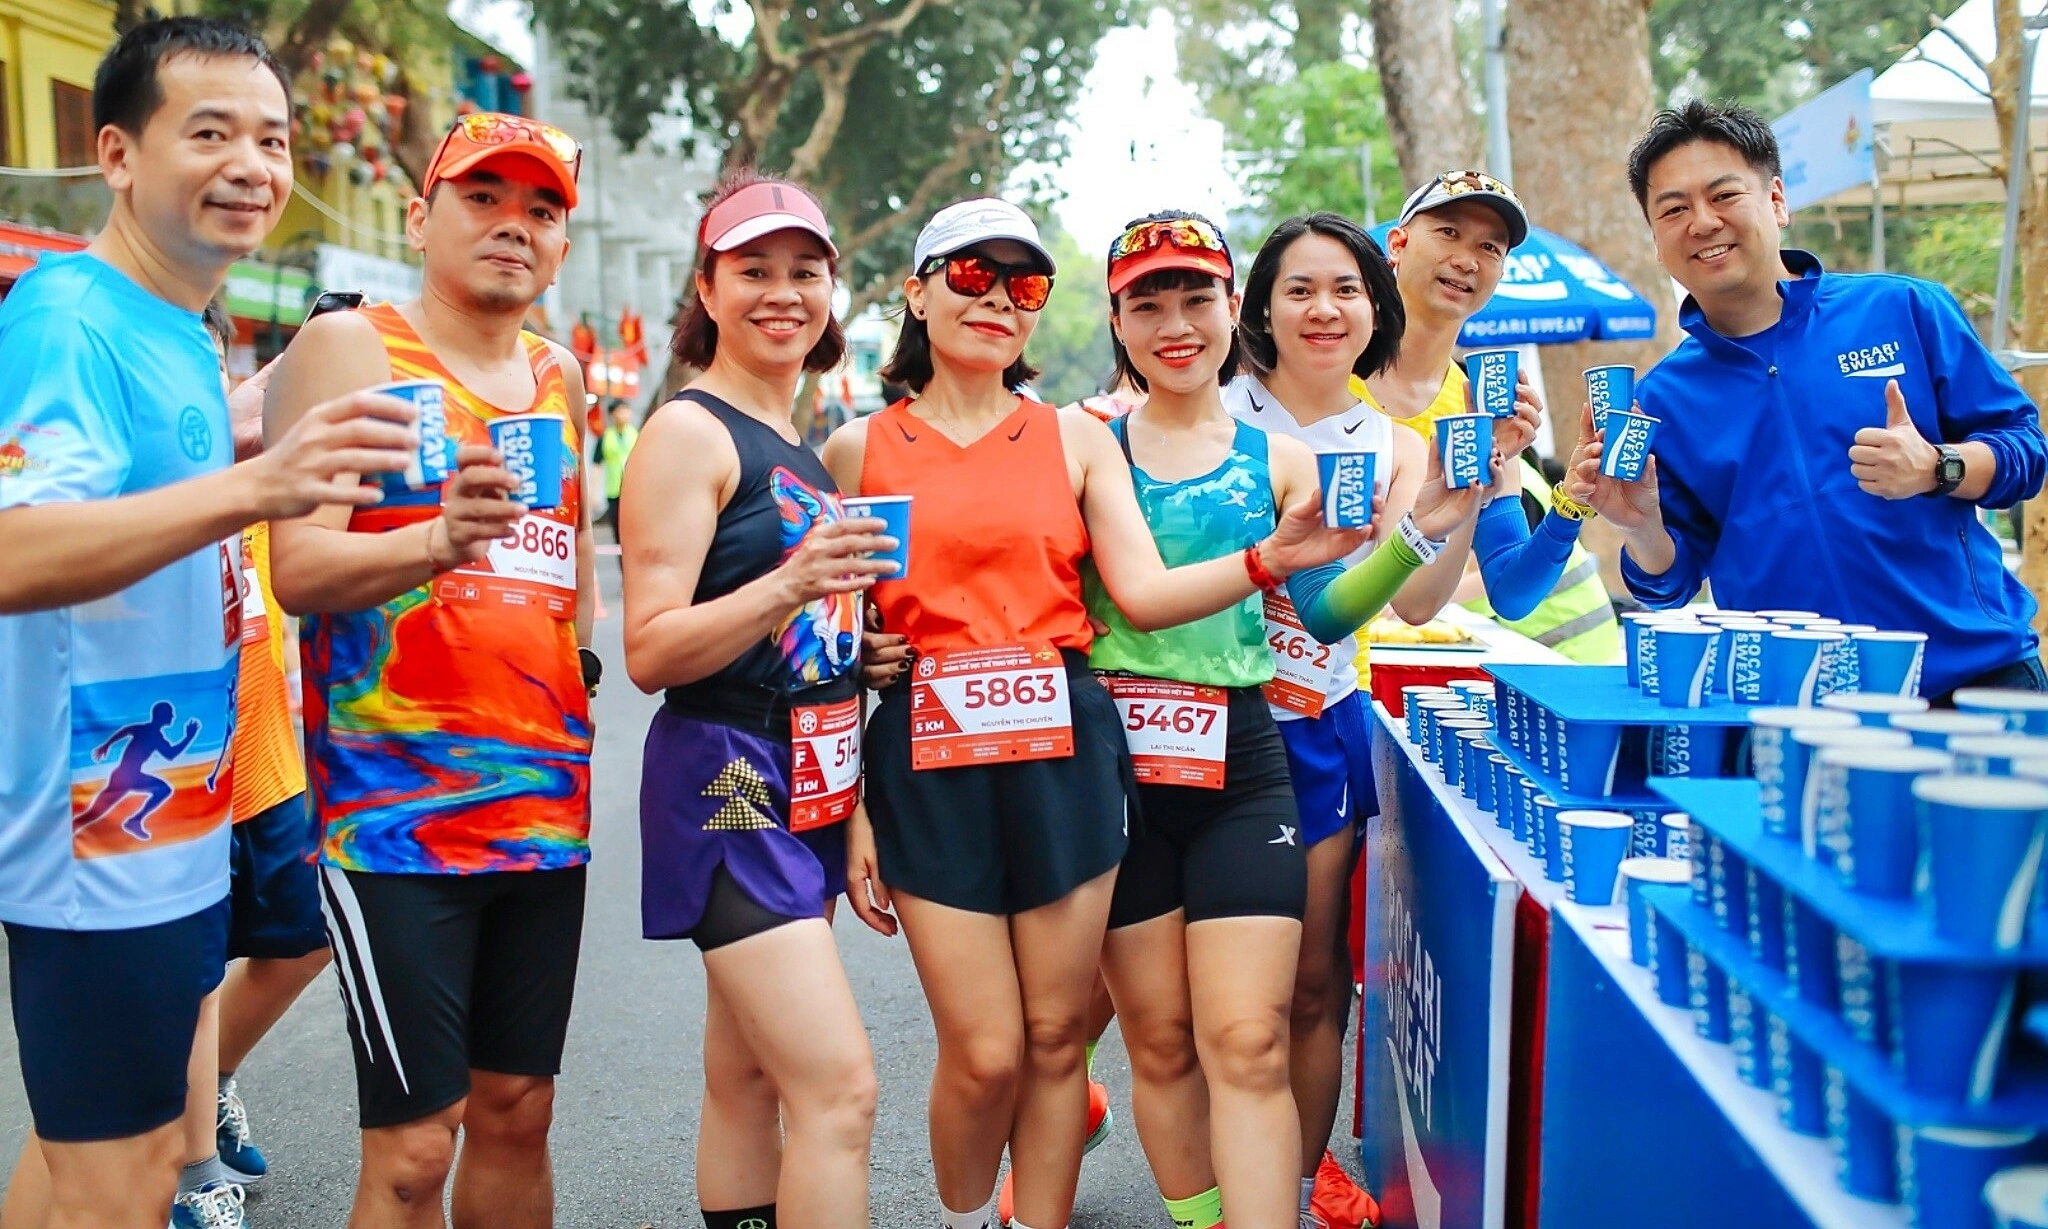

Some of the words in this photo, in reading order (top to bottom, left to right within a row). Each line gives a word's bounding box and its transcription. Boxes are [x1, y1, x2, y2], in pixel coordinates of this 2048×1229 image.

[1464, 316, 1527, 338] POCARI
[1529, 315, 1586, 334] SWEAT
[1837, 341, 1900, 364] POCARI
[1484, 355, 1499, 409] SWEAT
[1495, 353, 1510, 413] POCARI
[1840, 350, 1897, 373] SWEAT
[1589, 373, 1603, 422] SWEAT
[1597, 370, 1611, 425] POCAR
[515, 420, 538, 503] POCARI
[1452, 420, 1468, 480] SWEAT
[1463, 418, 1480, 484] POCARI
[1618, 418, 1641, 472] SWEAT
[1627, 420, 1651, 478] POCARI
[1340, 456, 1354, 519] SWEAT
[1352, 455, 1365, 524] POCARI
[1268, 630, 1331, 670] 46-2
[1639, 628, 1651, 687] SWEAT
[1736, 633, 1748, 694] SWEAT
[1746, 633, 1762, 701] POCARI
[914, 693, 925, 709] F
[964, 674, 1057, 709] 5863
[1126, 703, 1218, 736] 5467
[915, 722, 924, 733] 5
[925, 720, 945, 732] KM
[1537, 706, 1550, 774] POCARI
[1556, 720, 1570, 791] POCARI
[1677, 724, 1690, 775] POCA
[795, 750, 806, 769] F
[795, 783, 802, 794] 5
[803, 780, 818, 793] KM
[1523, 788, 1536, 856] POCARI
[1559, 823, 1576, 901] POCARI
[1388, 872, 1441, 1062] POCARI
[1387, 951, 1435, 1133] SWEAT
